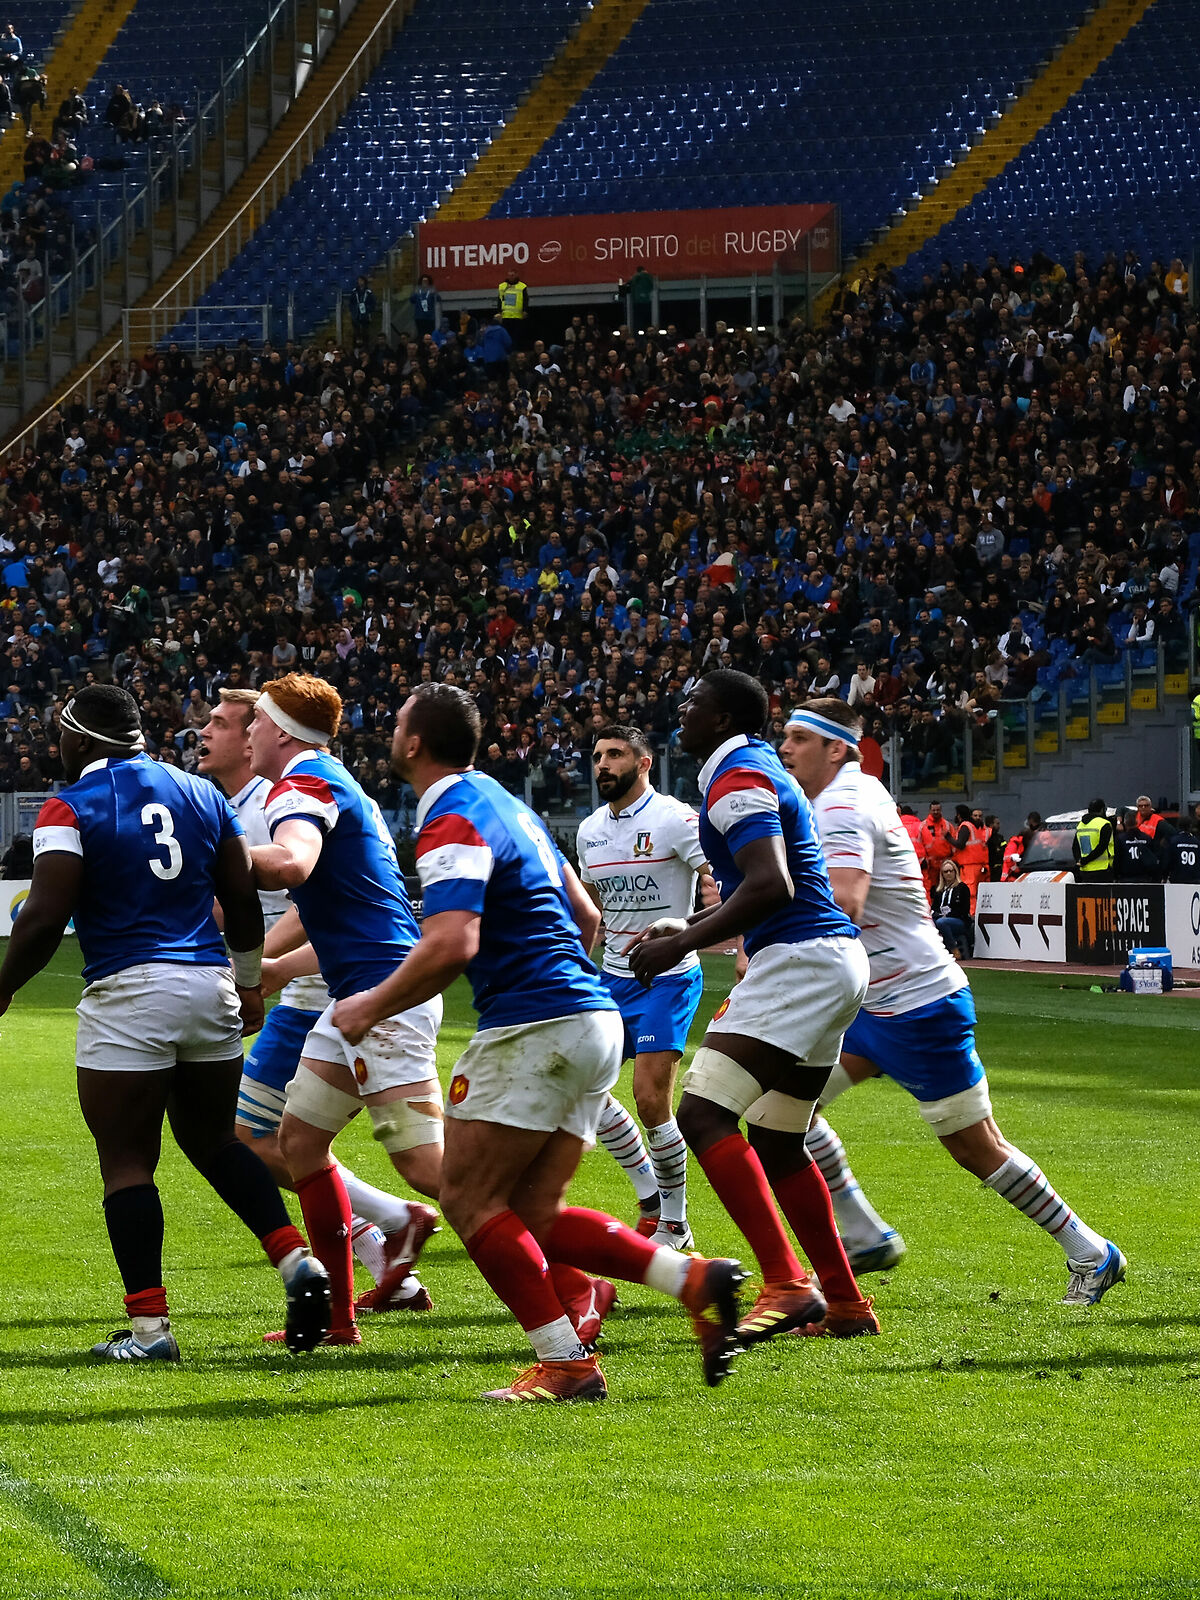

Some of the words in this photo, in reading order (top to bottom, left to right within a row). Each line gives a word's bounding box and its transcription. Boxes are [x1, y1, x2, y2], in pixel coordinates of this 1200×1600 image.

[427, 246, 446, 268] III
[450, 242, 530, 267] TEMPO
[594, 235, 679, 260] SPIRITO
[725, 229, 801, 254] RUGBY
[141, 803, 183, 880] 3
[1181, 851, 1196, 866] 90
[1117, 897, 1150, 933] SPACE
